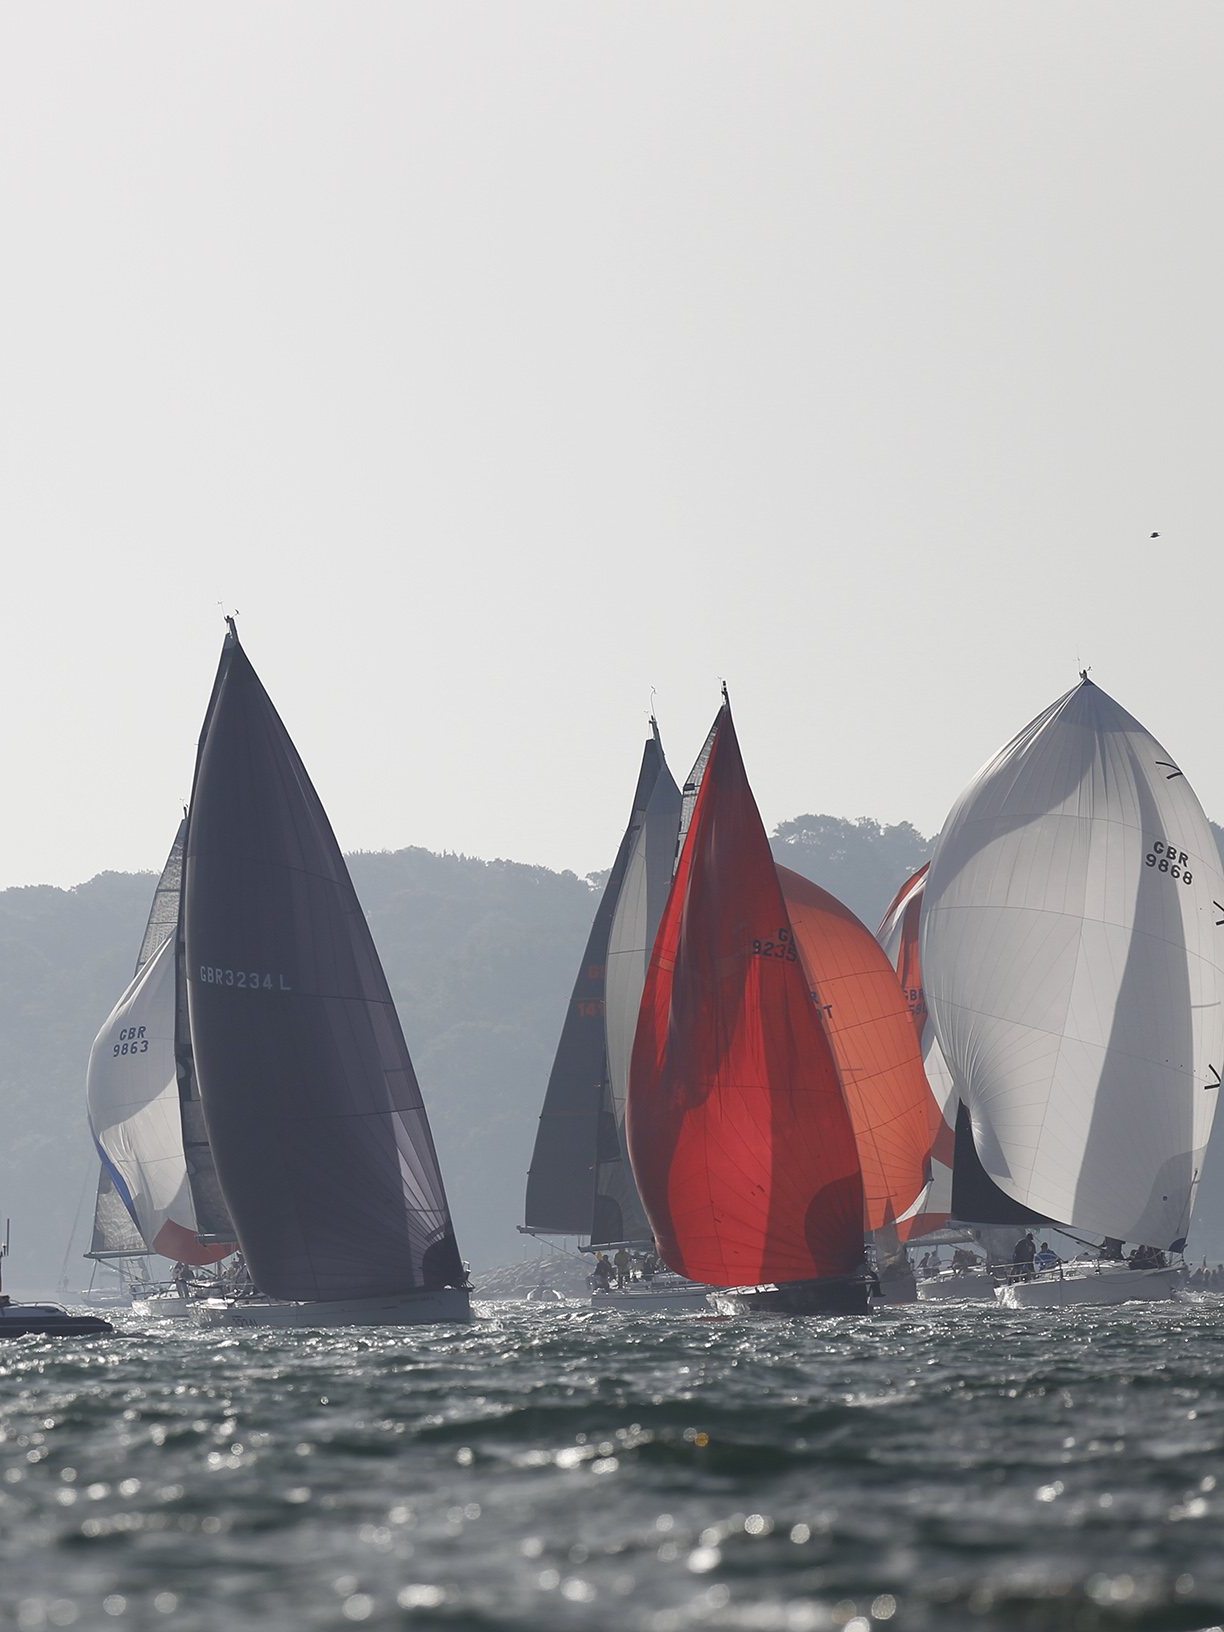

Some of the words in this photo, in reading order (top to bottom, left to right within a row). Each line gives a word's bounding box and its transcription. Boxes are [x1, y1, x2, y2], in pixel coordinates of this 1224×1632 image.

[1153, 841, 1189, 868] GBR
[1145, 853, 1193, 885] 9868
[119, 1025, 147, 1041] GBR
[113, 1040, 149, 1057] 9863
